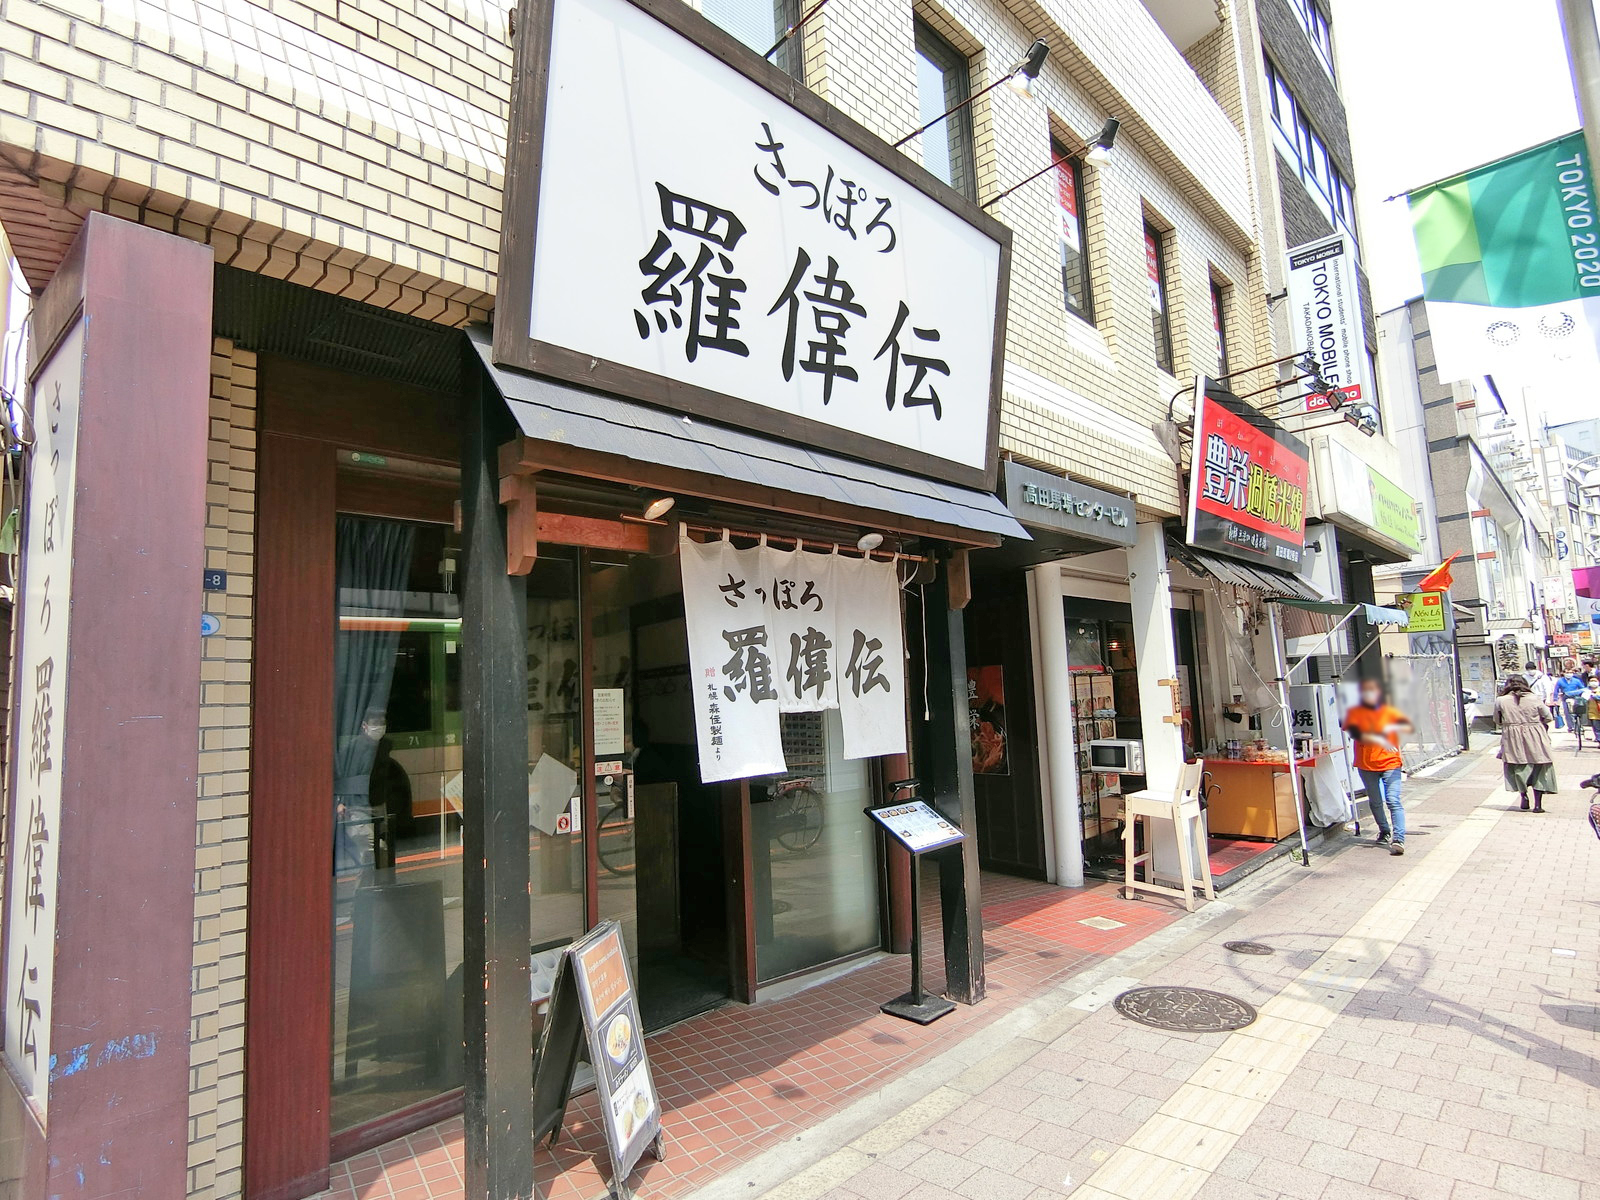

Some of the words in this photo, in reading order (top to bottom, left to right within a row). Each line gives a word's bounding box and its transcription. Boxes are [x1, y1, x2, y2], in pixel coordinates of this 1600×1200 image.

[753, 121, 897, 253] さっぽろ
[1555, 152, 1593, 229] TOKYO
[1293, 255, 1315, 266] TOKYO
[1570, 233, 1600, 288] 2020
[633, 181, 951, 421] 羅偉伝
[1311, 262, 1332, 320] TOKYO
[1023, 481, 1129, 528] 高田馬場センタービル
[718, 573, 824, 612] さっぽろ
[722, 624, 891, 704] 羅偉伝
